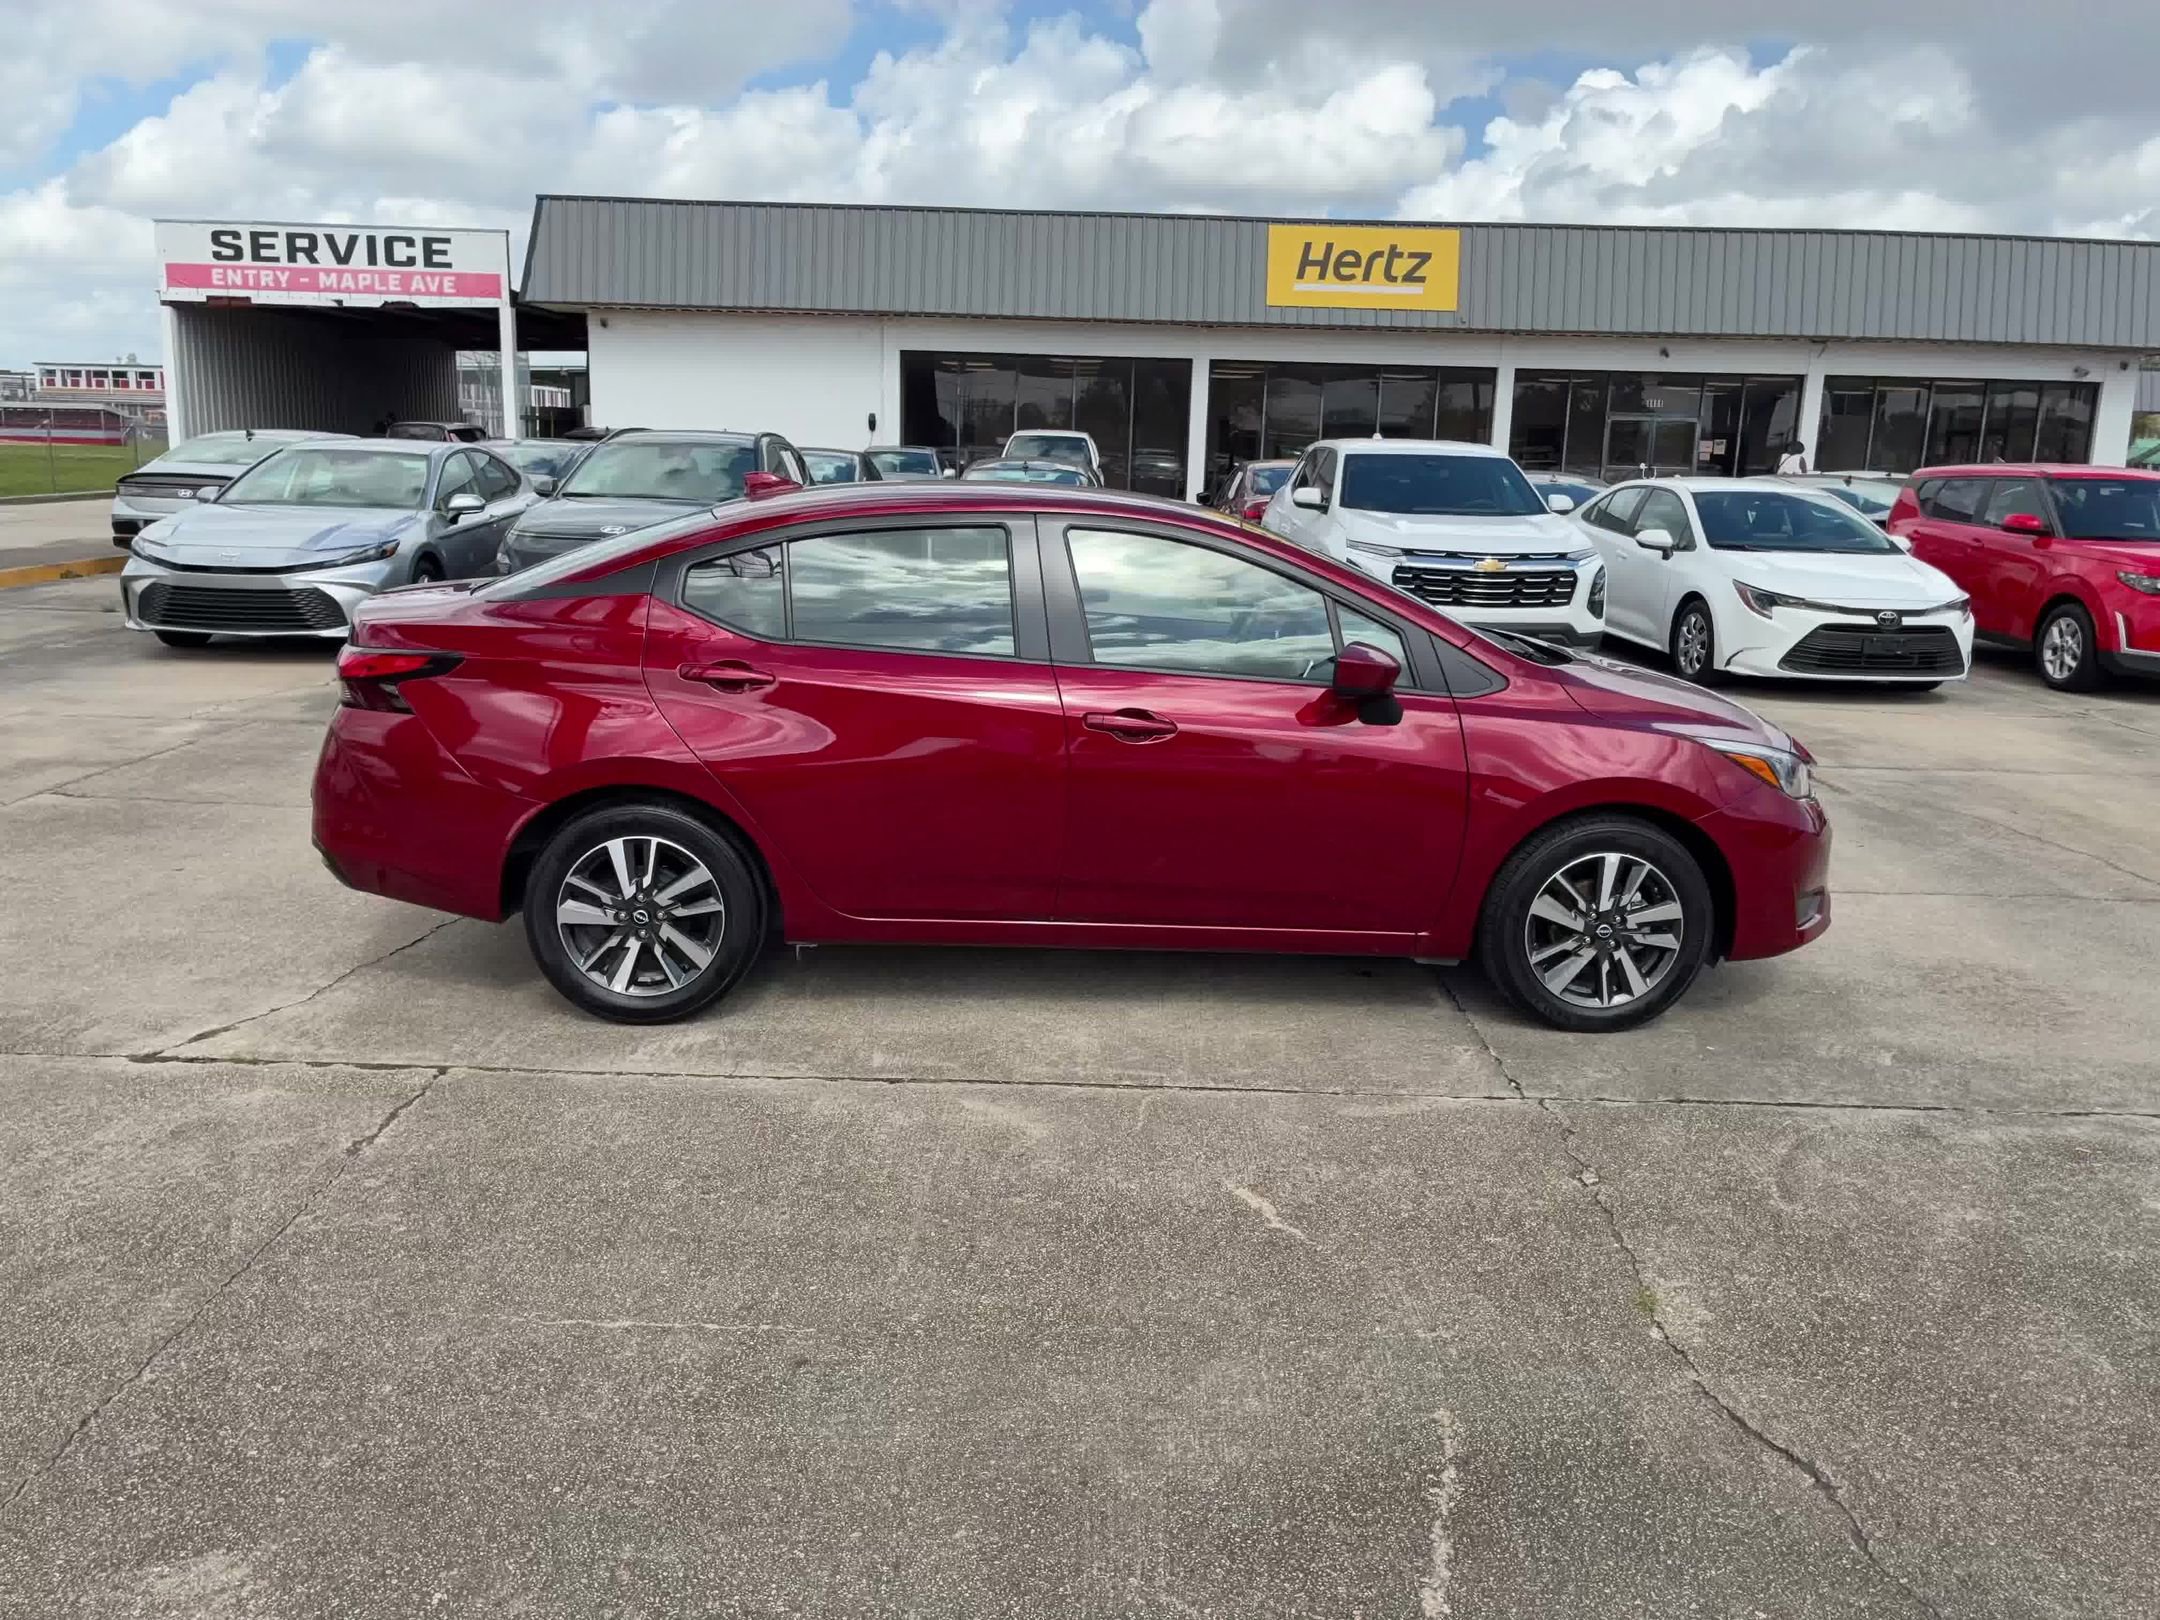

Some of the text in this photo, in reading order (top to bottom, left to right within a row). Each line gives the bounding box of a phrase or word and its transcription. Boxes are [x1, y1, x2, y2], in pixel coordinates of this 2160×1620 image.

[211, 230, 453, 268] SERVICE
[1296, 241, 1433, 284] Hertz
[211, 268, 289, 288] ENTRY
[318, 271, 401, 291] MAPLE
[409, 275, 457, 294] AVE
